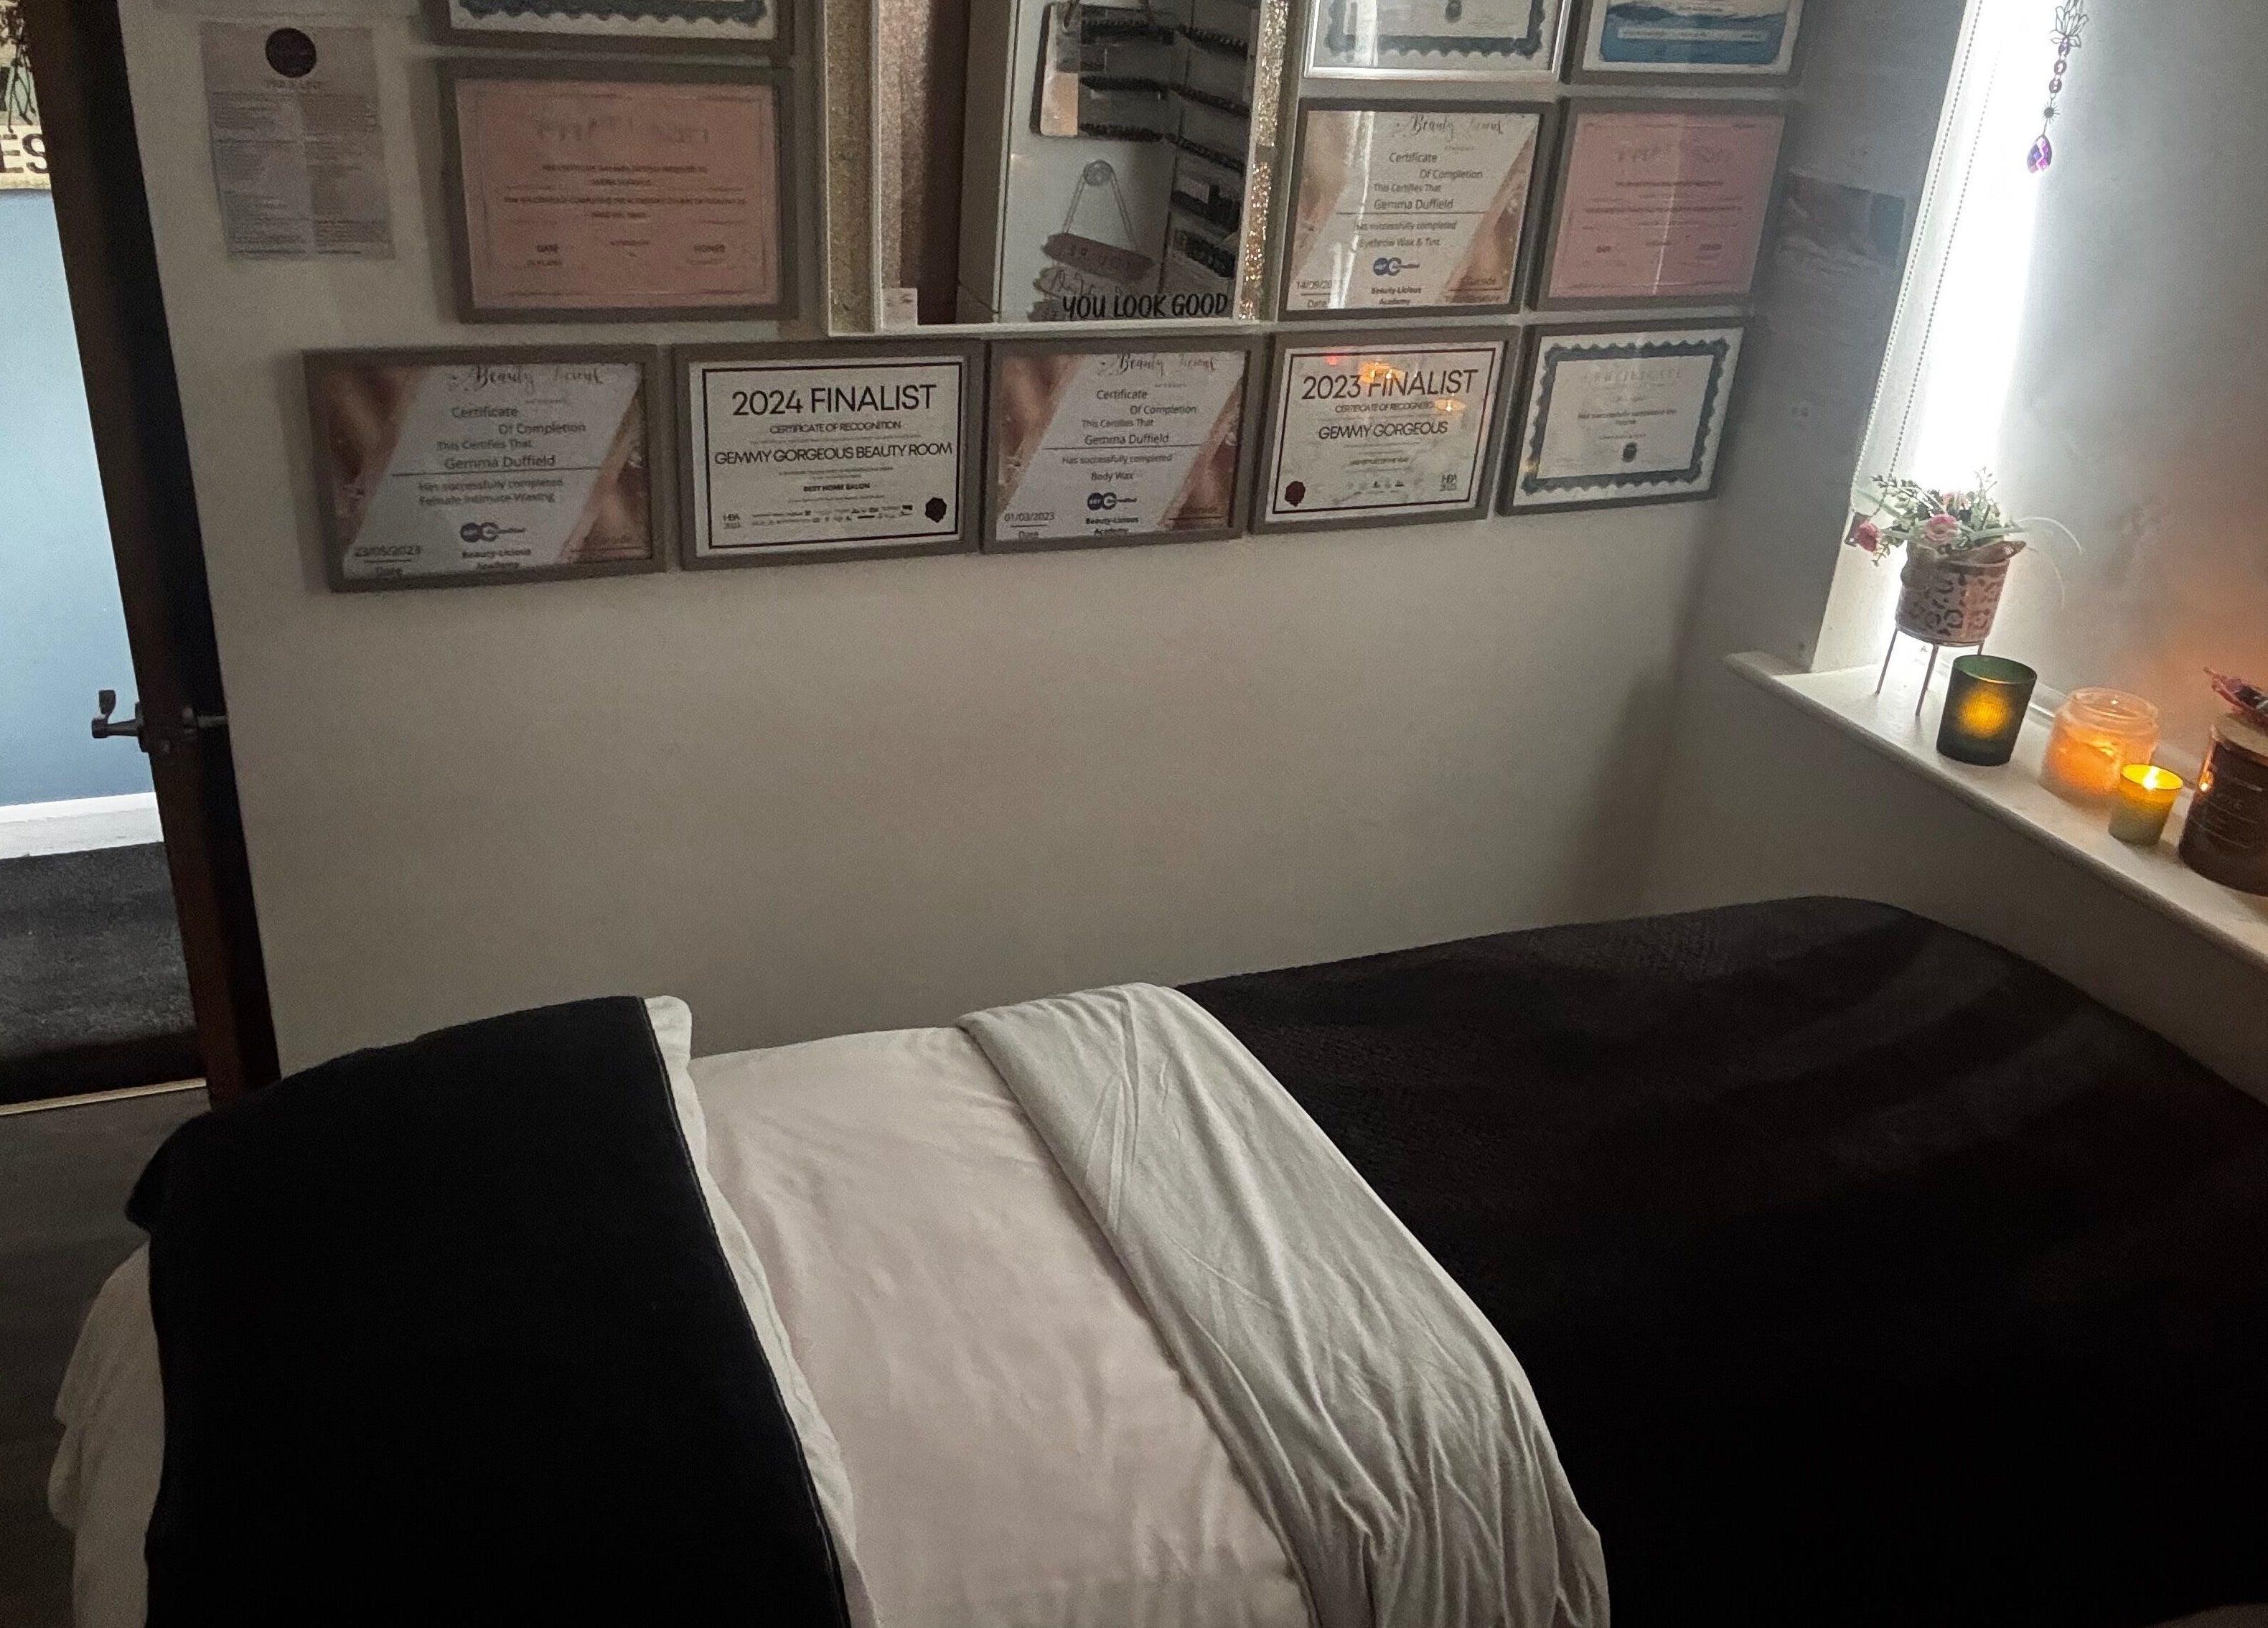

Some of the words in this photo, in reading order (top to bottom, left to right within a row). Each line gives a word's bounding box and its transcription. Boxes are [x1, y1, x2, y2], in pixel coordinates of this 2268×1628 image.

[1389, 152, 1438, 163] Certificate
[1420, 170, 1432, 179] Of
[1433, 169, 1484, 181] Completion
[1374, 184, 1390, 192] This
[1374, 200, 1413, 210] Gemma
[1063, 294, 1106, 318] YOU
[1114, 294, 1167, 317] LOOK
[1172, 293, 1228, 316] GOOD
[1302, 375, 1362, 400] 2023
[1367, 369, 1479, 397] FINALIST
[732, 390, 803, 416] 2024
[811, 384, 937, 413] FINALIST
[1097, 390, 1148, 401] Certificate
[451, 406, 518, 418] Certificate
[1130, 405, 1143, 414] Of
[1143, 404, 1197, 416] Completion
[1335, 403, 1378, 413] CERTIFICATE
[499, 424, 512, 434] Of
[516, 423, 586, 436] Completion
[770, 423, 825, 434] CERTIFICATE
[825, 423, 840, 433] OF
[840, 421, 901, 432] RECOGNITION
[1319, 426, 1370, 440] GEMMY
[1373, 421, 1448, 437] GORGEOUS
[1085, 434, 1126, 445] Gemma
[715, 450, 772, 464] GEMMY
[774, 446, 854, 462] GORGEOUS
[856, 444, 906, 459] BEAUTY
[909, 442, 952, 456] ROOM
[446, 457, 499, 471] Gemma
